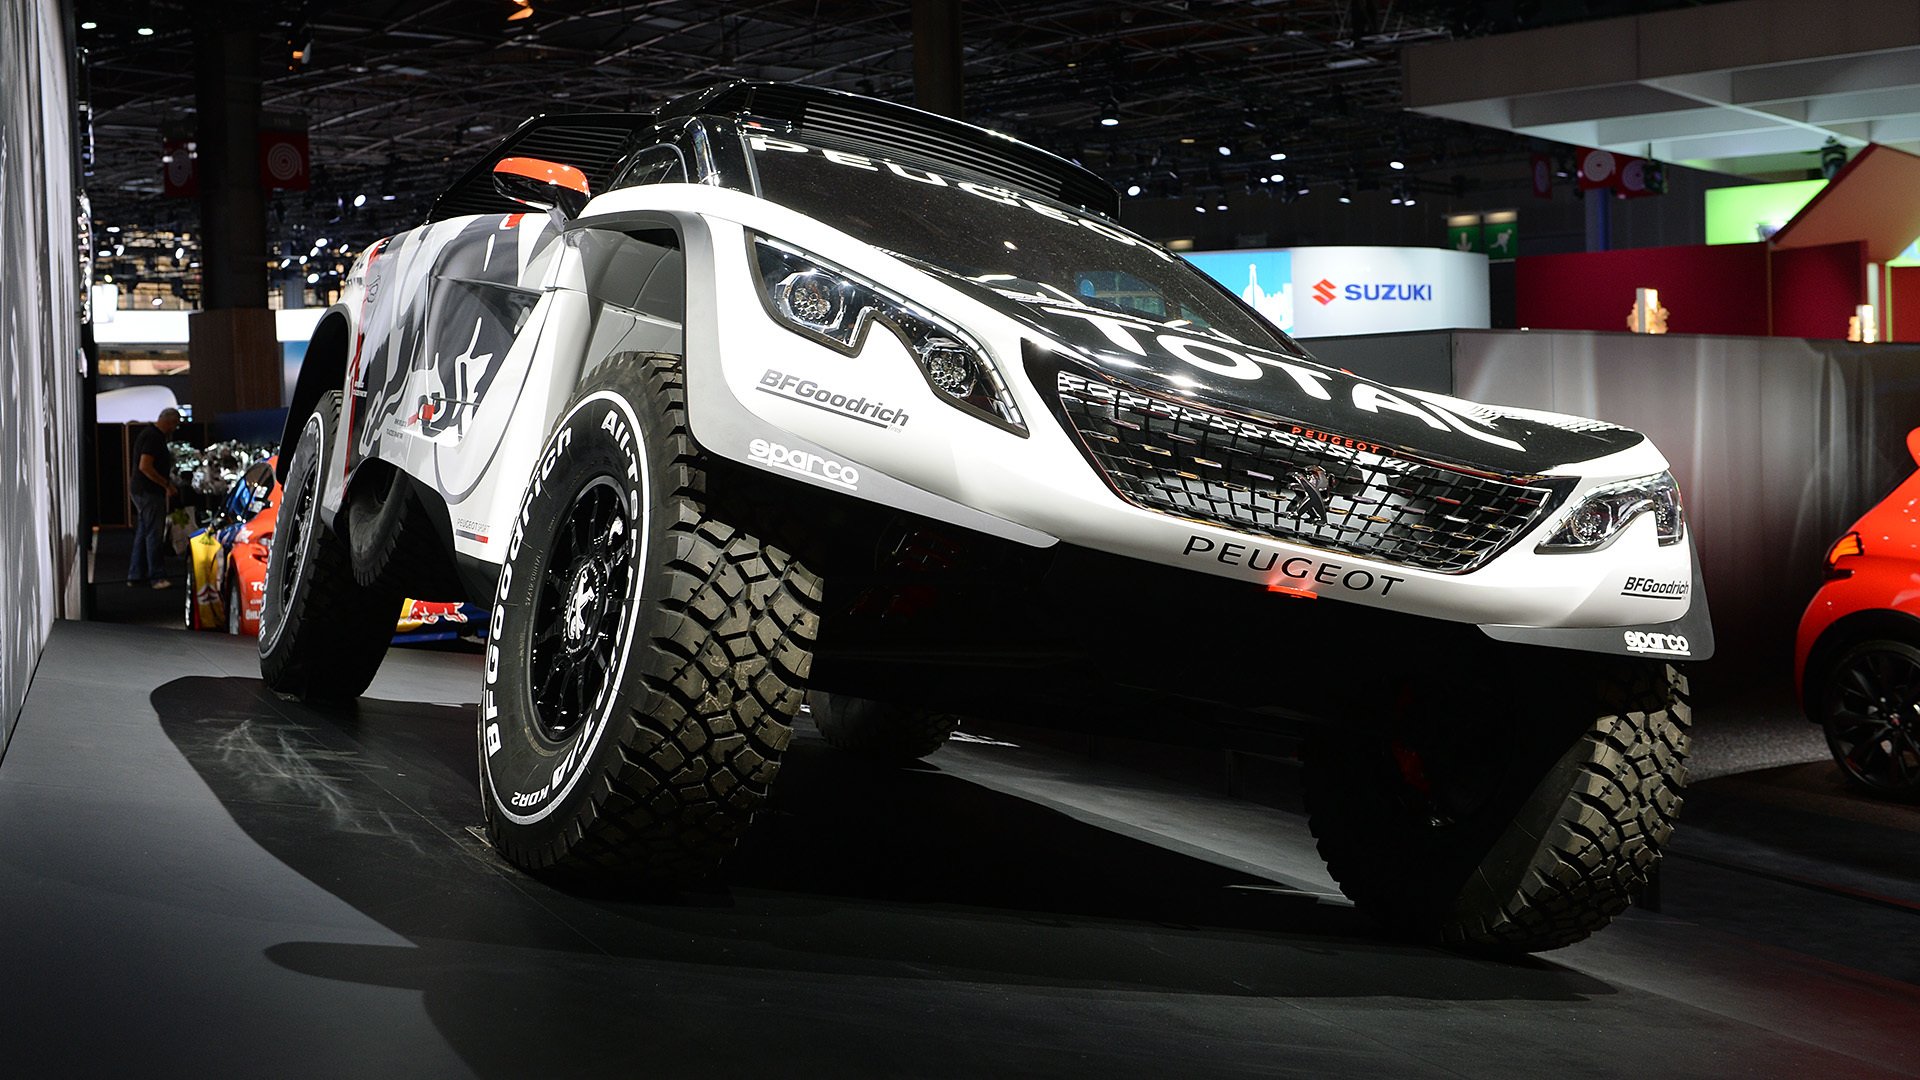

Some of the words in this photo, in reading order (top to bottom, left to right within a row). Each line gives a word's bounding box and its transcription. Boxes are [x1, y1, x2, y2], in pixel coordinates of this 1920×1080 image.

[1345, 284, 1431, 301] SUZUKI
[759, 369, 909, 427] BFGoodrich
[1041, 306, 1526, 452] TOTAL
[1291, 425, 1380, 454] PEUGEOT
[748, 438, 860, 491] sparco
[1182, 535, 1405, 596] PEUGEOT
[1623, 576, 1689, 594] BFGoodrich
[486, 427, 573, 757] BFGoodrich
[1623, 630, 1691, 656] sparco
[511, 785, 550, 808] KDR2
